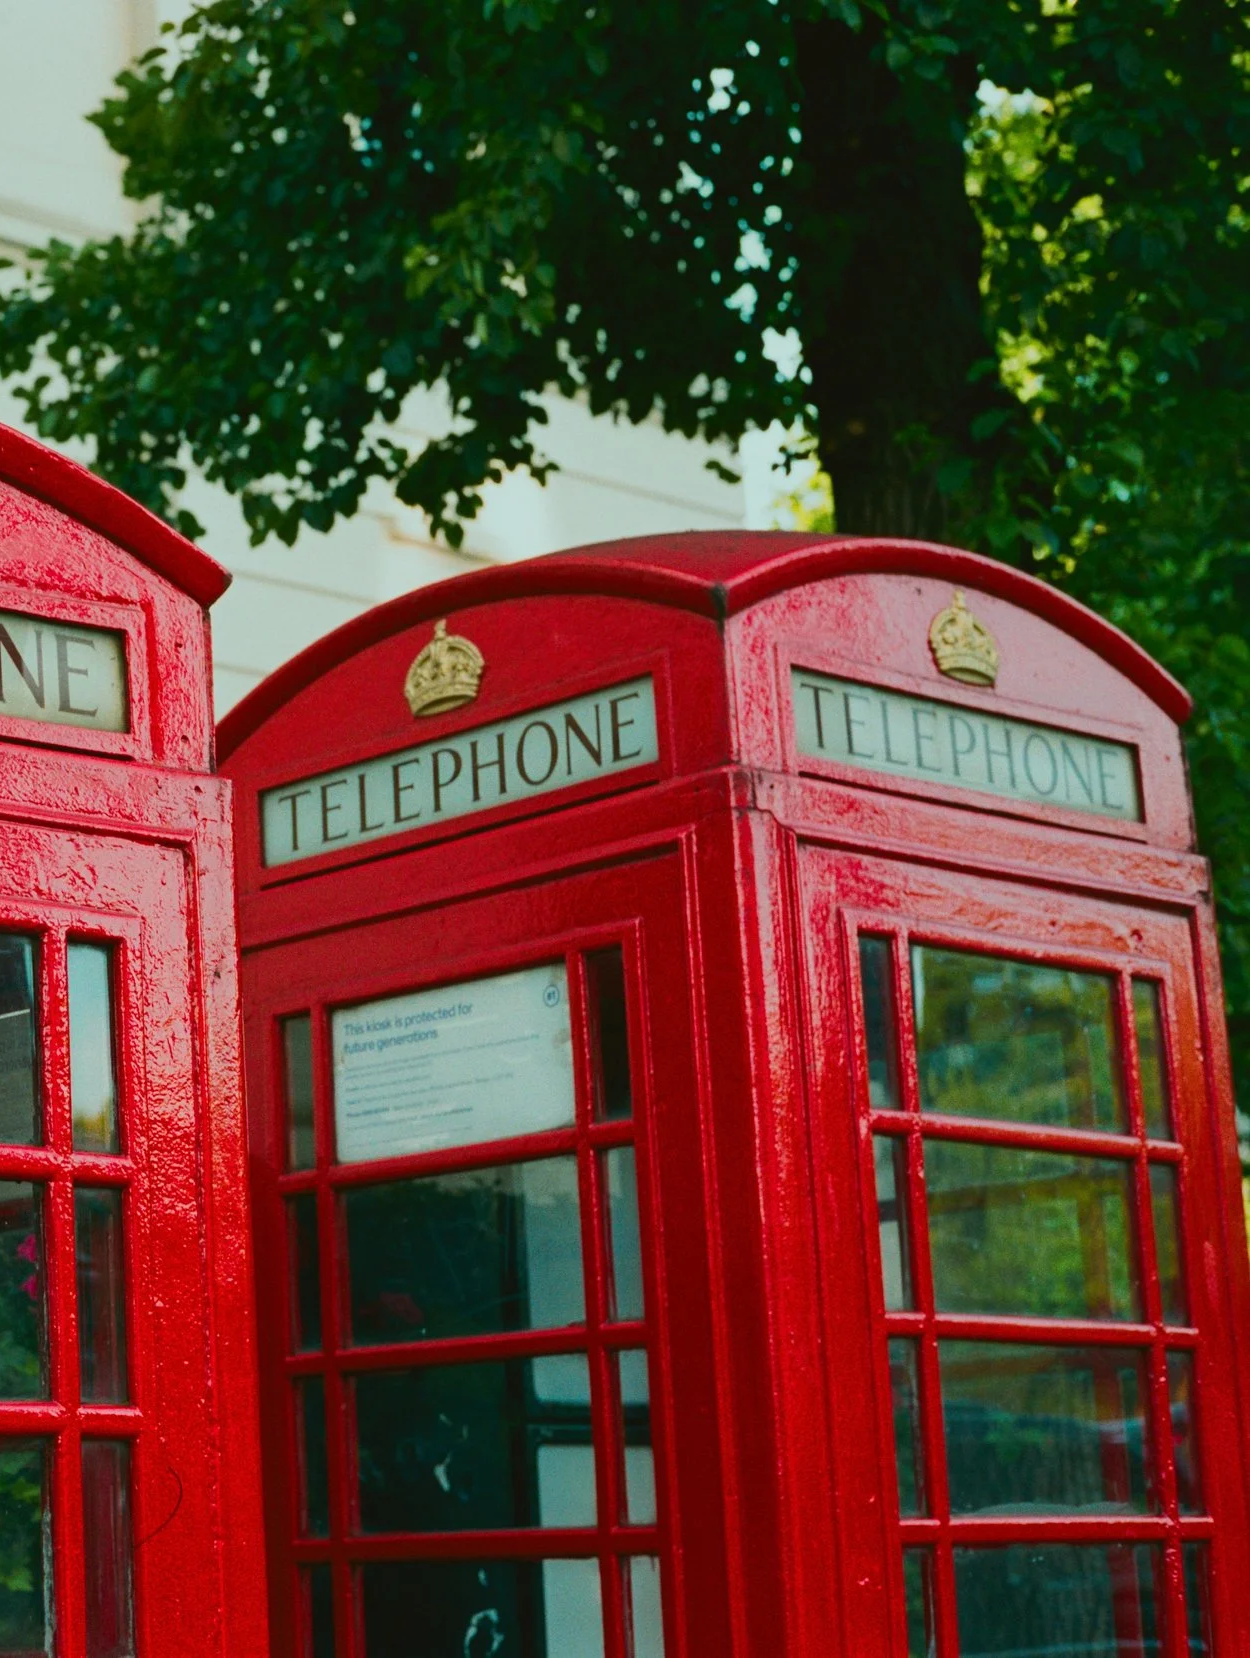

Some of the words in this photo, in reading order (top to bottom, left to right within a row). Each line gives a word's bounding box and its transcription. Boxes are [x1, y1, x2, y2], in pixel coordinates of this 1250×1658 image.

[278, 692, 642, 852] TELEPHONE
[801, 683, 1125, 811] TELEPHONE
[343, 1023, 364, 1036] This
[366, 1017, 391, 1032] kiosk
[394, 1014, 403, 1028] is
[403, 1004, 456, 1029] protected
[458, 1003, 473, 1016] for
[343, 1039, 375, 1055] future
[377, 1029, 438, 1052] generations
